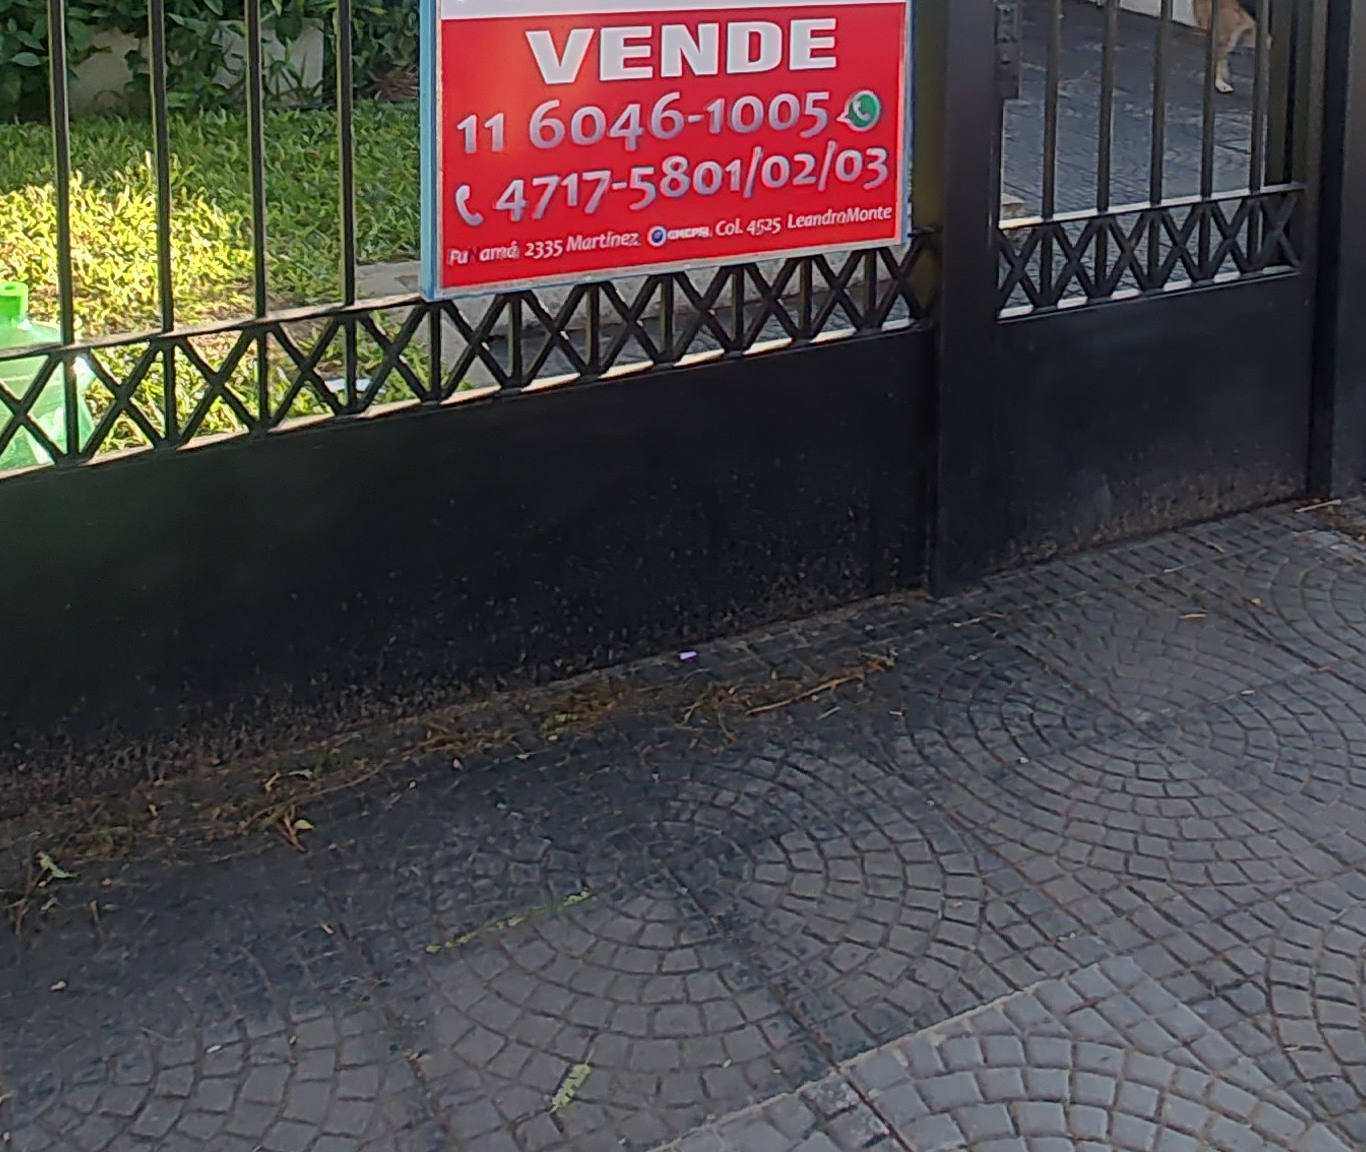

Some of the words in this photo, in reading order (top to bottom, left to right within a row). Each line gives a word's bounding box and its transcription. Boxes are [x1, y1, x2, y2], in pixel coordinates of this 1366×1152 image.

[525, 17, 838, 85] VENDE
[456, 113, 505, 154] 11
[528, 91, 831, 150] 6046-1005
[495, 140, 889, 222] 4717-5801/02/03
[524, 239, 563, 260] 2335
[566, 231, 641, 253] Martínez
[715, 219, 742, 236] Col.
[746, 217, 782, 236] 4525
